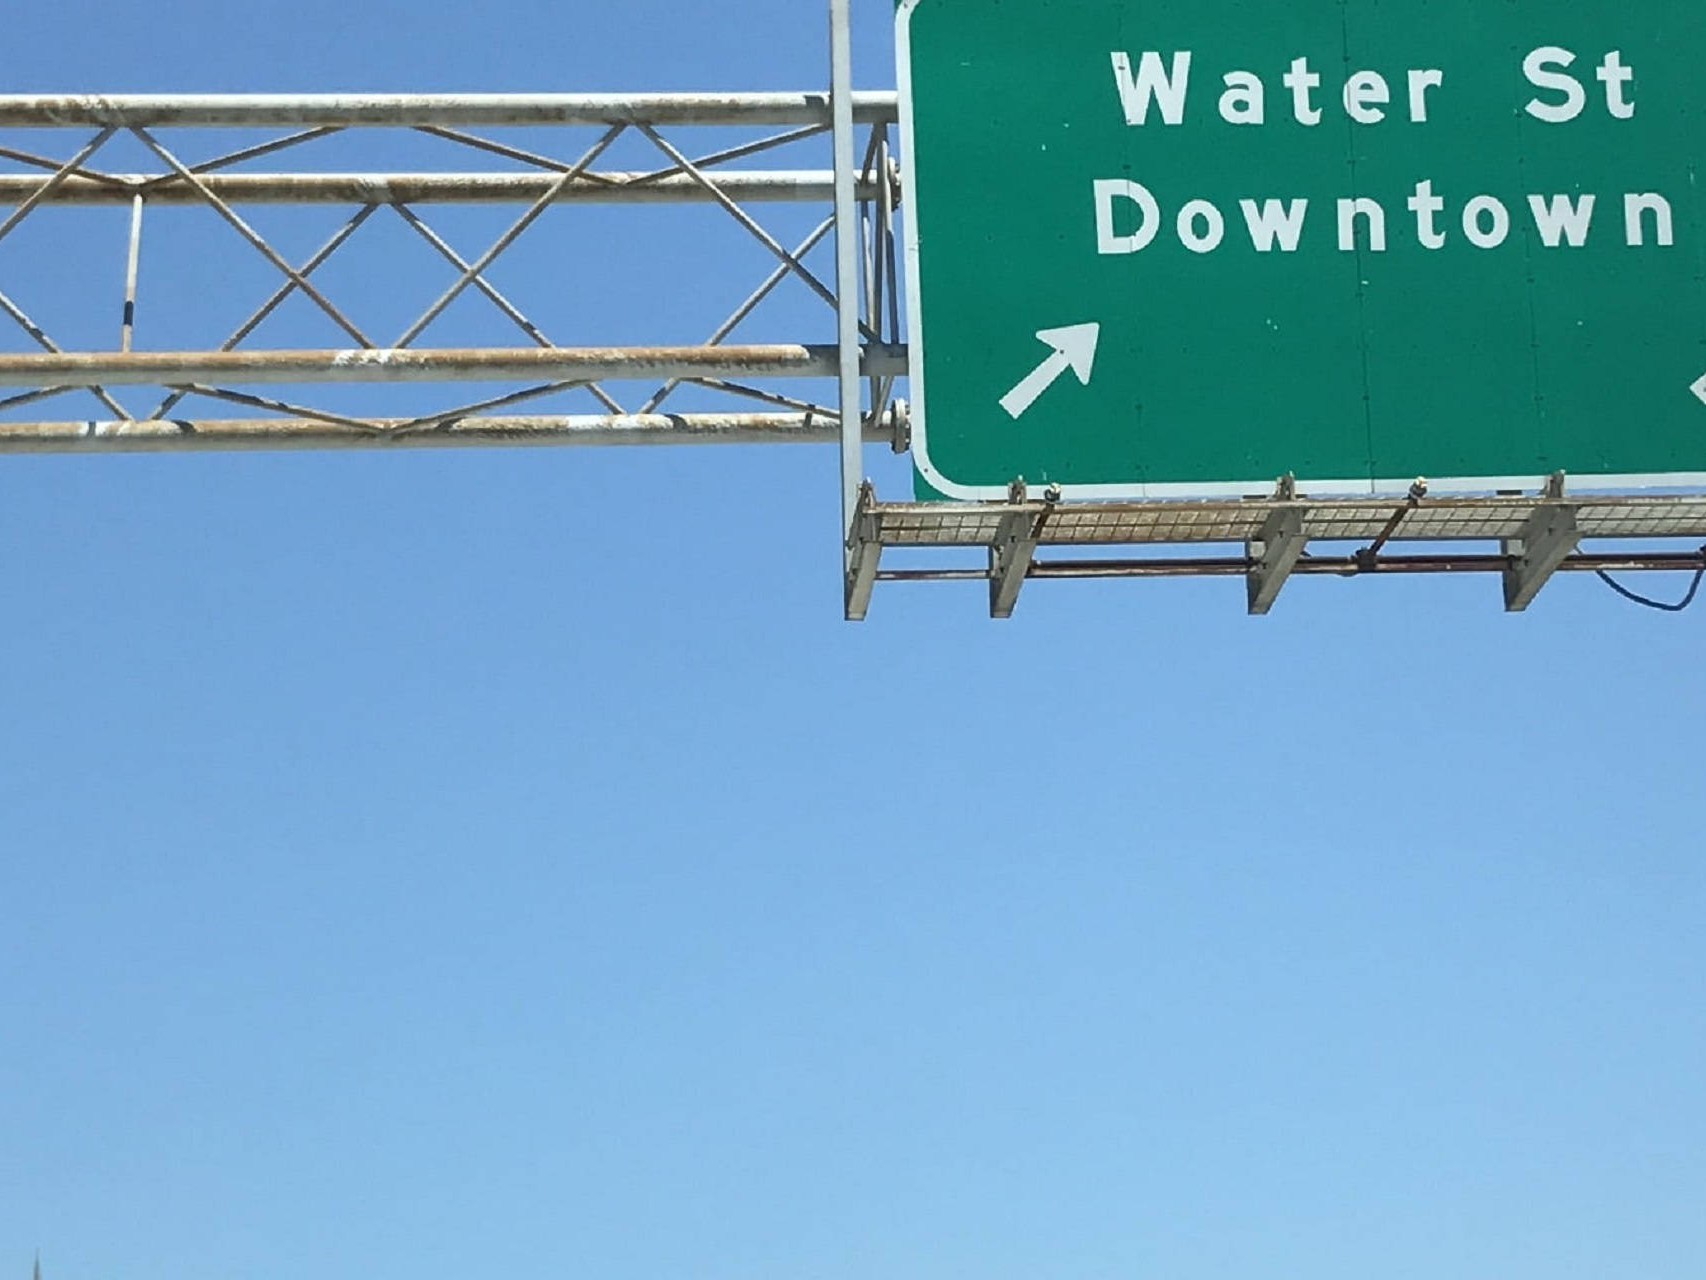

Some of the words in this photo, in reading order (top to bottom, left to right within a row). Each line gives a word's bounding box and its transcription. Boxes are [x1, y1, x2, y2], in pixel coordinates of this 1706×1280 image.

[1109, 50, 1443, 126] Water
[1522, 46, 1636, 123] St
[1092, 178, 1674, 254] Downtown
